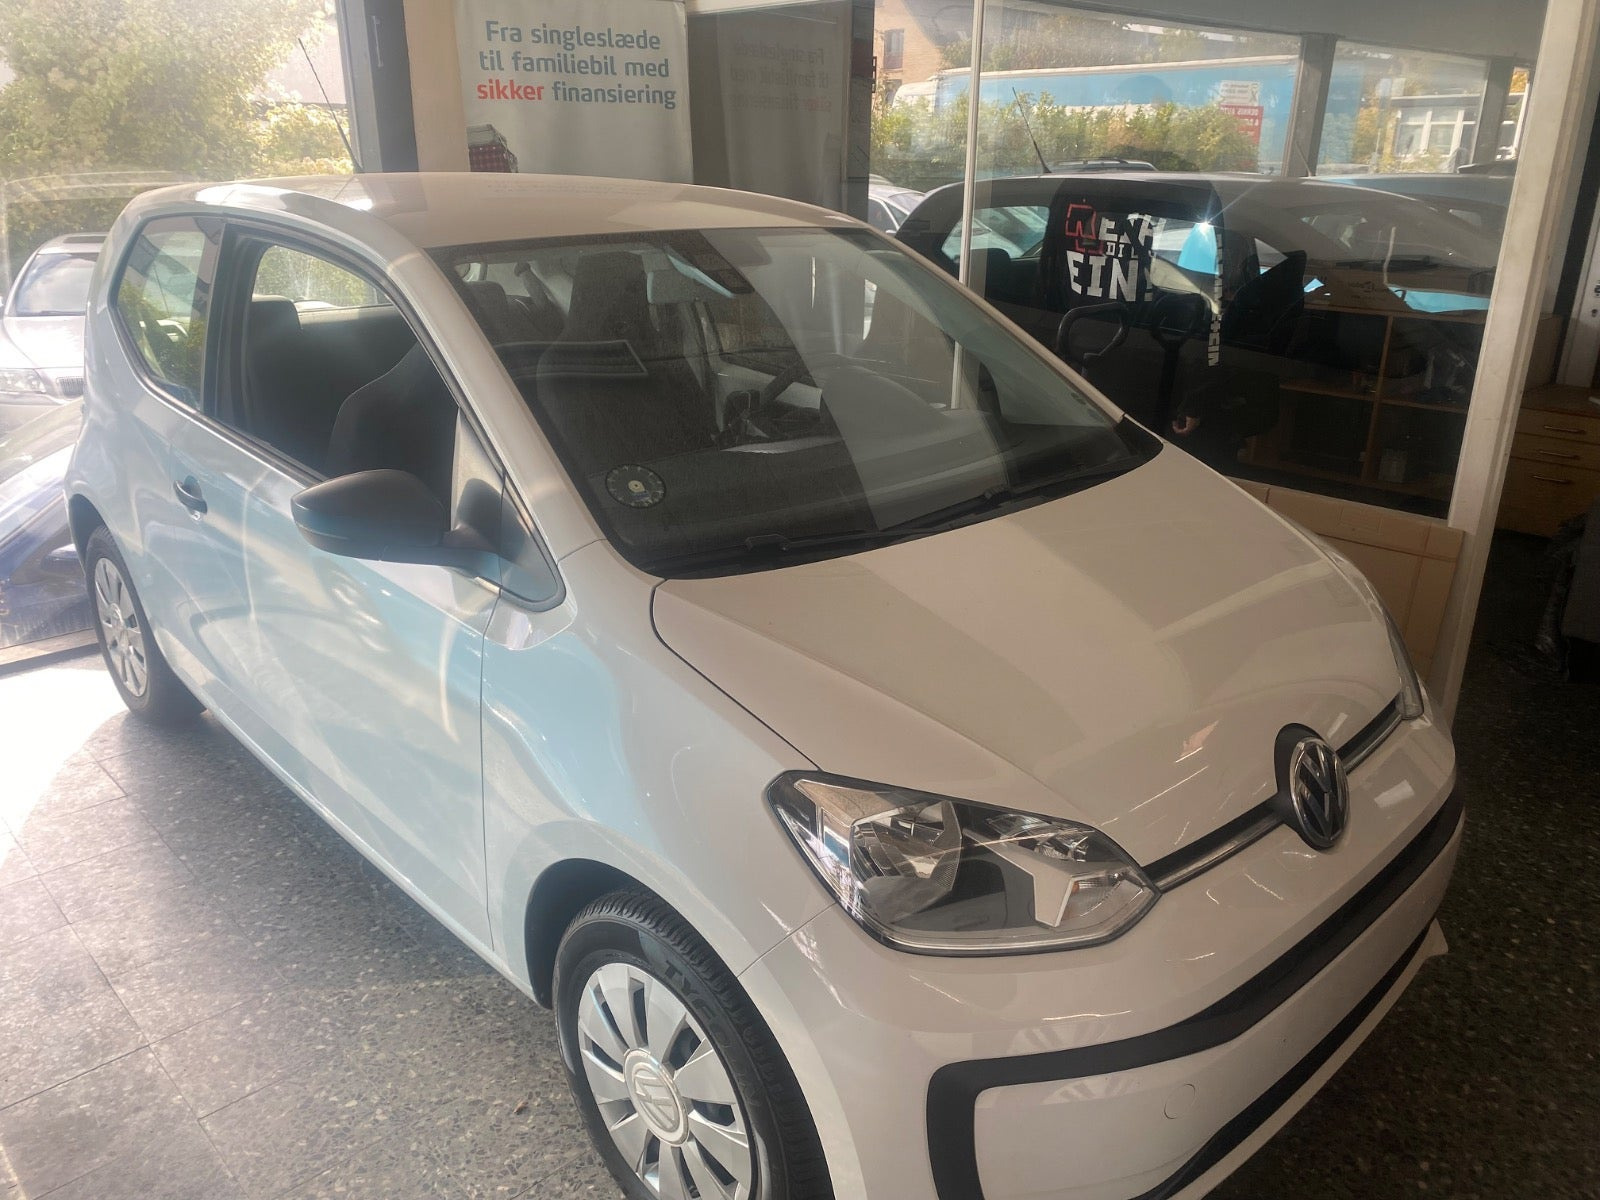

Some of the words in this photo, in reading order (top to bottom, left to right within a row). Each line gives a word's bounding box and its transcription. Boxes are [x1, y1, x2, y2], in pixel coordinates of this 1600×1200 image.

[485, 20, 522, 42] Fra
[530, 23, 661, 51] singleslæde
[479, 50, 505, 71] til
[511, 50, 618, 76] familiebil
[624, 58, 670, 77] med
[477, 79, 544, 101] sikker
[552, 81, 677, 110] finansiering
